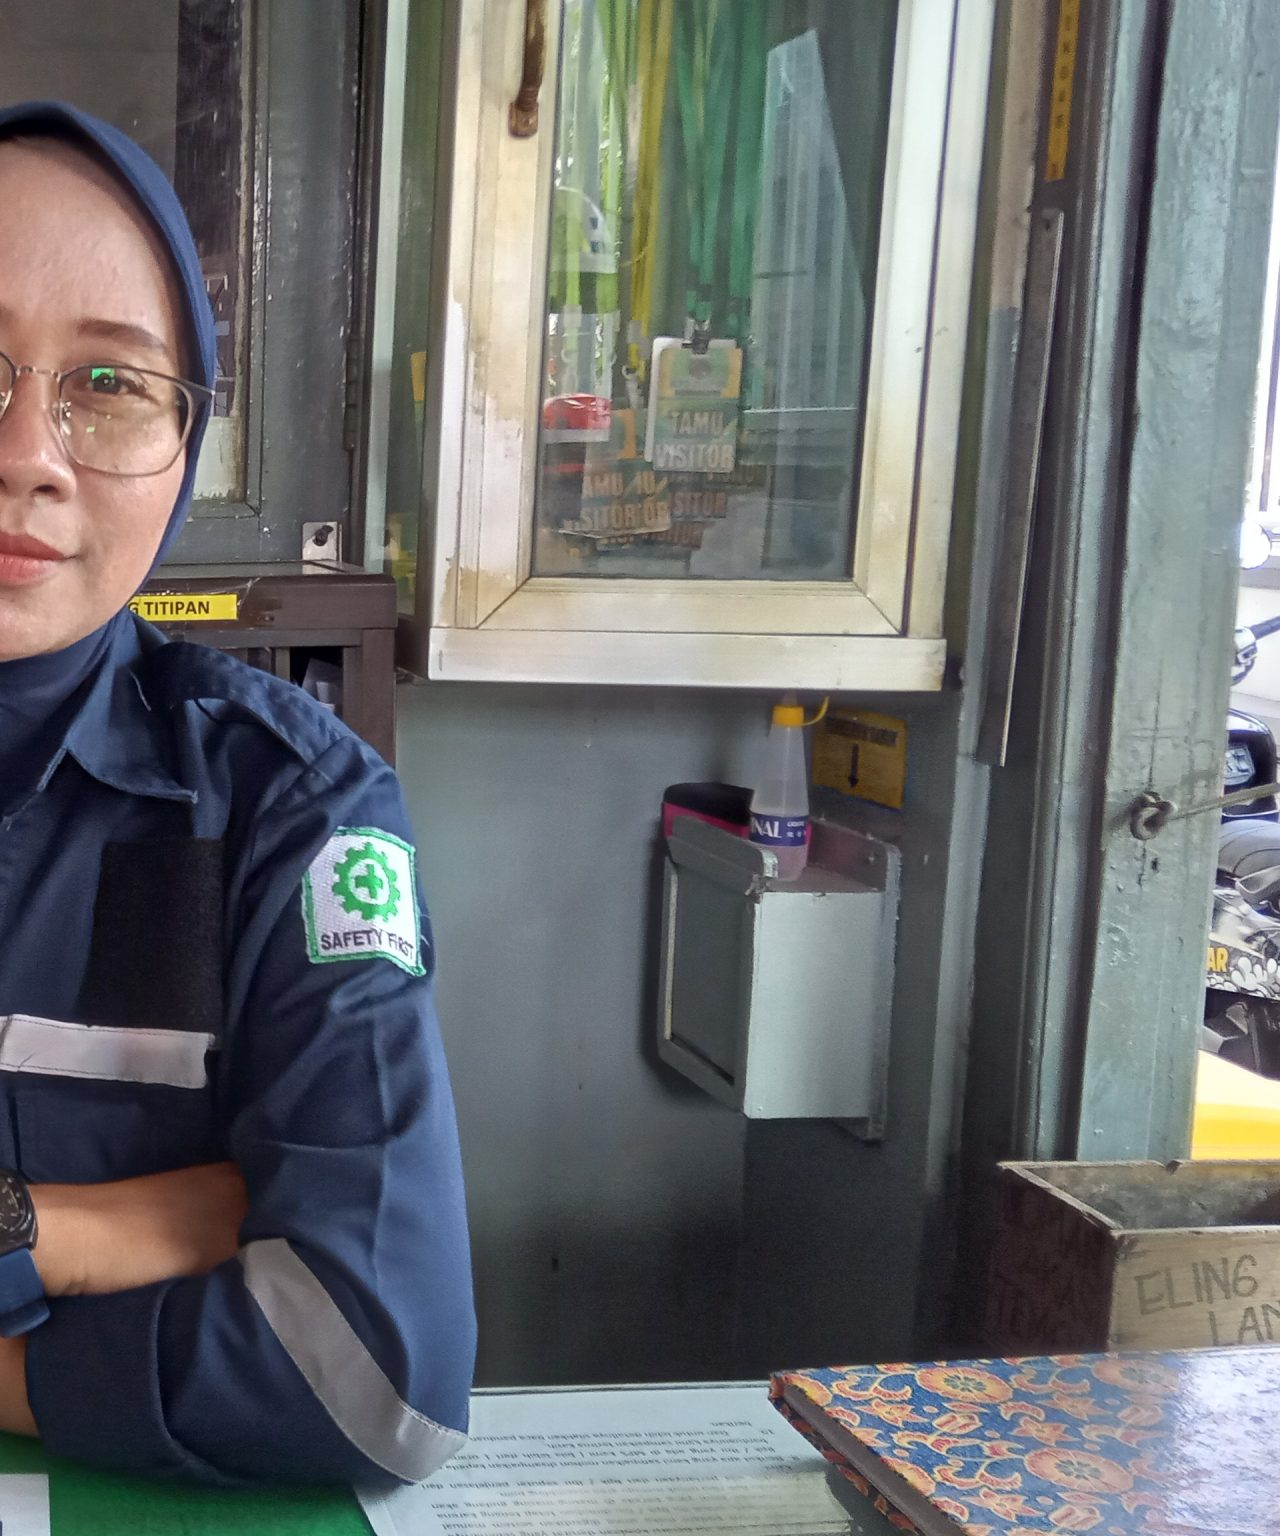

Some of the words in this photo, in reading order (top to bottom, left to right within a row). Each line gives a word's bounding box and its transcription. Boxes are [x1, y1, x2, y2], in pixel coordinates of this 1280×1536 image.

[671, 411, 724, 437] TAMU
[656, 443, 735, 469] VISITOR
[583, 472, 624, 497] AMU
[144, 601, 210, 615] TITIPAN
[321, 928, 384, 950] SAFETY
[387, 932, 414, 960] FIRST
